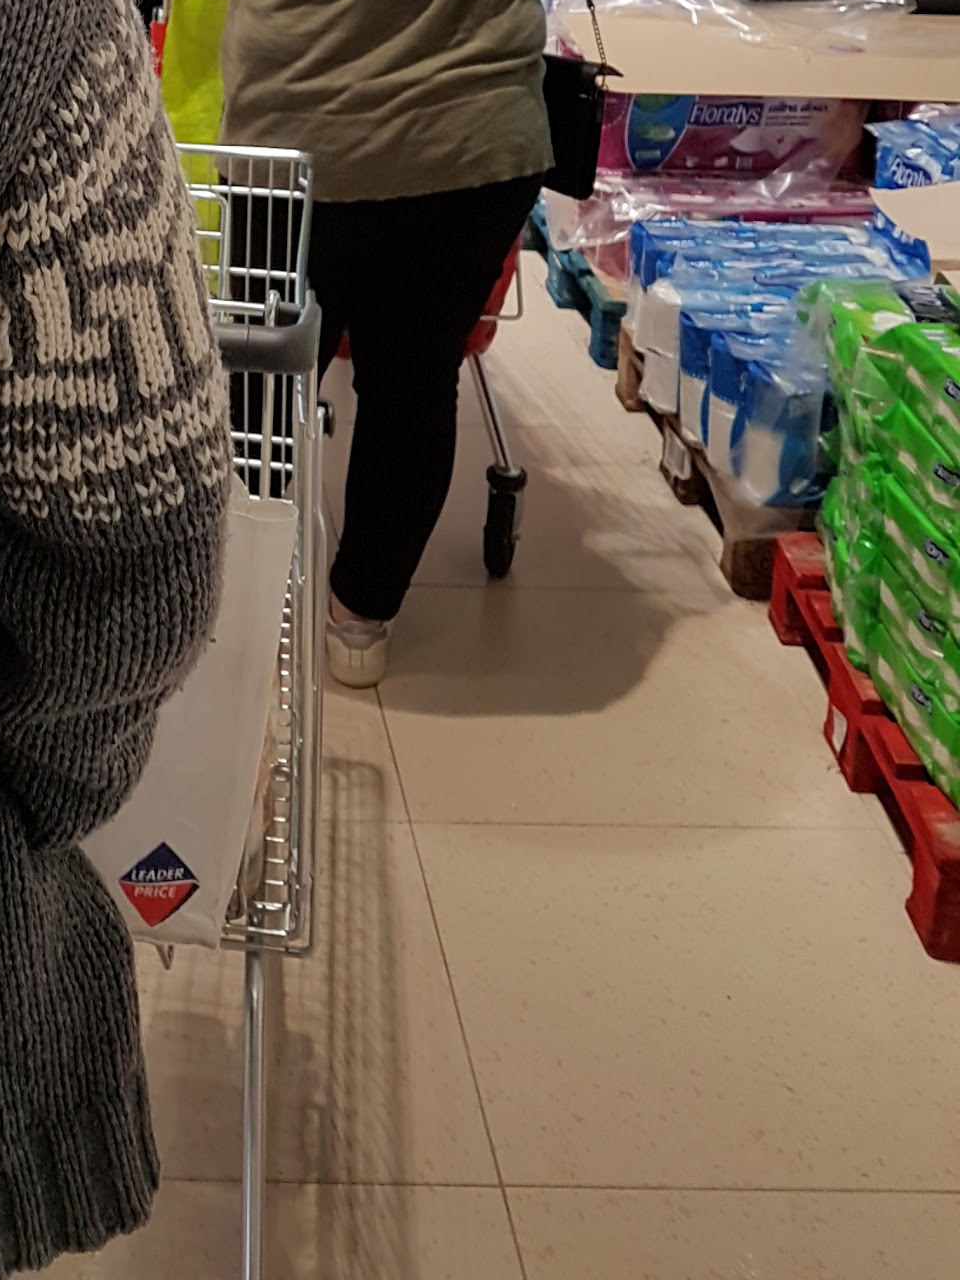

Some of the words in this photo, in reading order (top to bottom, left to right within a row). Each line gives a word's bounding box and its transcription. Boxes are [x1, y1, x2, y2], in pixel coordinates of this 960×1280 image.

[689, 103, 761, 128] Floralys
[131, 867, 186, 882] LEADER
[133, 885, 178, 899] PRICE
